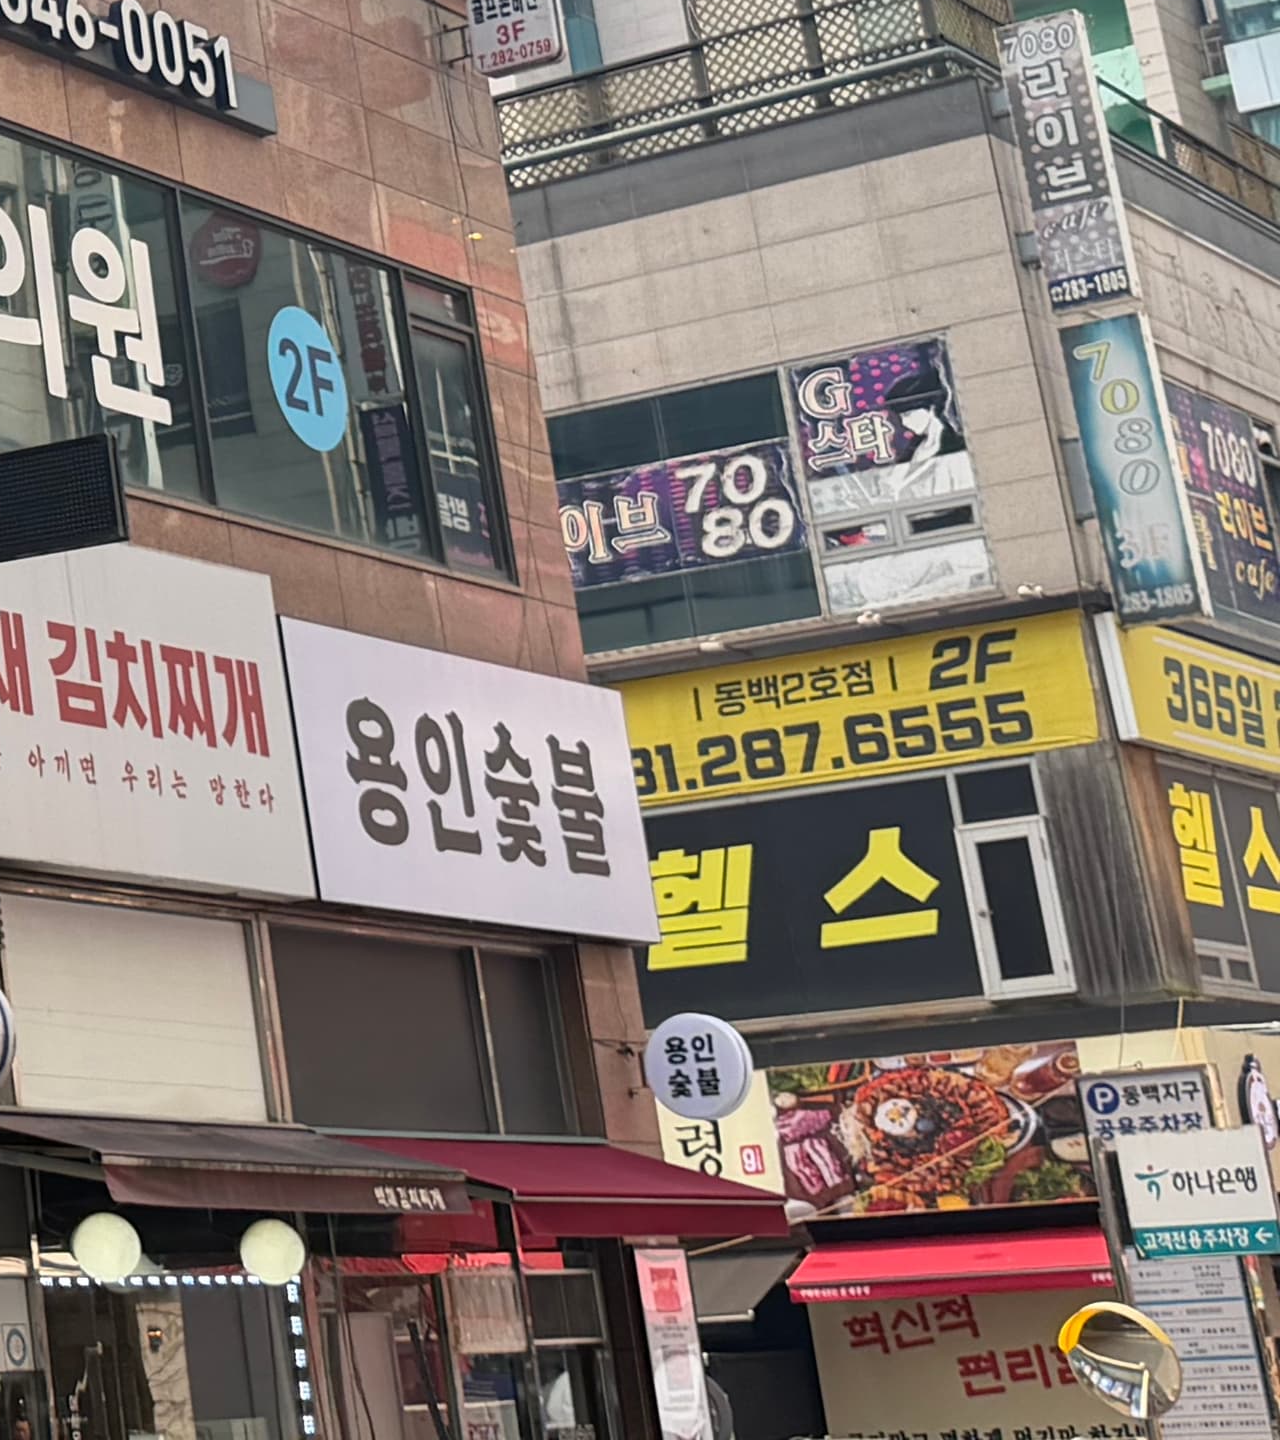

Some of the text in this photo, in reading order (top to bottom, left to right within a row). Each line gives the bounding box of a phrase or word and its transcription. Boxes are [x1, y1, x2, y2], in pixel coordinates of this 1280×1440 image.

[496, 19, 526, 46] 3F
[1003, 23, 1075, 62] 7080
[1020, 58, 1093, 202] 라이브
[1061, 269, 1127, 302] 283-1805
[278, 337, 335, 418] 2F
[806, 407, 896, 472] 스타
[1072, 340, 1160, 495] 7080
[675, 455, 769, 514] 70
[1200, 420, 1257, 489] 7080
[560, 489, 671, 564] 이브
[700, 497, 797, 559] 80
[1214, 490, 1274, 552] 라이브
[46, 621, 271, 759] 김치찌개
[713, 628, 1018, 720] 동백2호점 2F
[1163, 655, 1267, 749] 365일
[26, 743, 97, 786] 아끼면
[120, 760, 188, 802] 우리는
[209, 776, 277, 815] 망한다
[345, 696, 612, 879] 용인숯불
[647, 826, 941, 972] 헬스
[663, 1033, 715, 1064] 용인
[667, 1069, 722, 1099] 숯불
[1121, 1080, 1201, 1106] 동백지구
[1142, 1227, 1250, 1252] 고객전용주차장
[842, 1293, 981, 1354] 혁신적
